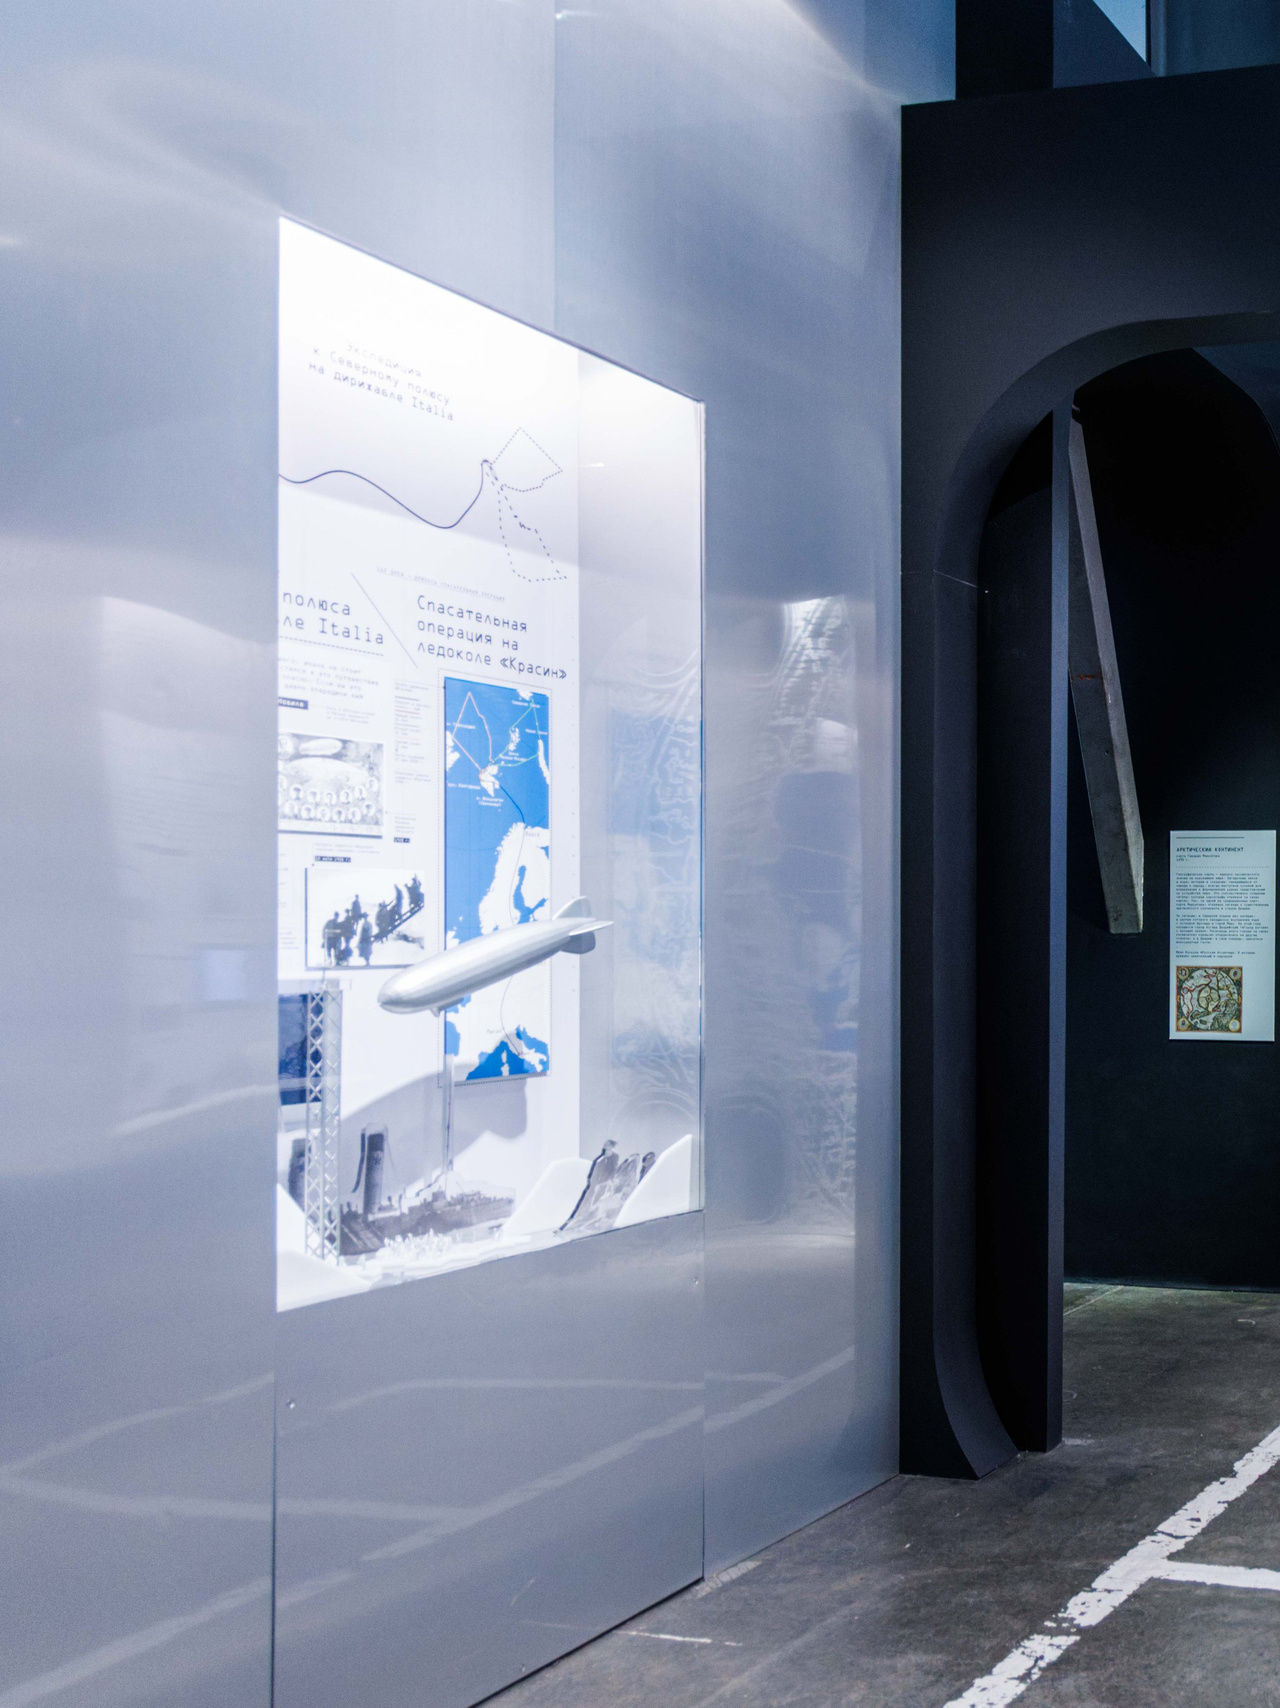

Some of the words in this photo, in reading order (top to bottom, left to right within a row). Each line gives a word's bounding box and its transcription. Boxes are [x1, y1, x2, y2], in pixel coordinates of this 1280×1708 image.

[309, 361, 325, 375] на
[333, 371, 404, 403] дирижабле
[412, 396, 454, 421] Italia
[330, 350, 400, 387] Северному
[407, 382, 451, 406] полюсу
[282, 592, 351, 616] полюса
[417, 594, 528, 633] Спасательная
[319, 617, 384, 645] Italia
[417, 620, 493, 645] операция
[502, 638, 519, 651] на
[417, 642, 492, 666] ледоколе
[500, 656, 567, 680] «Красин»
